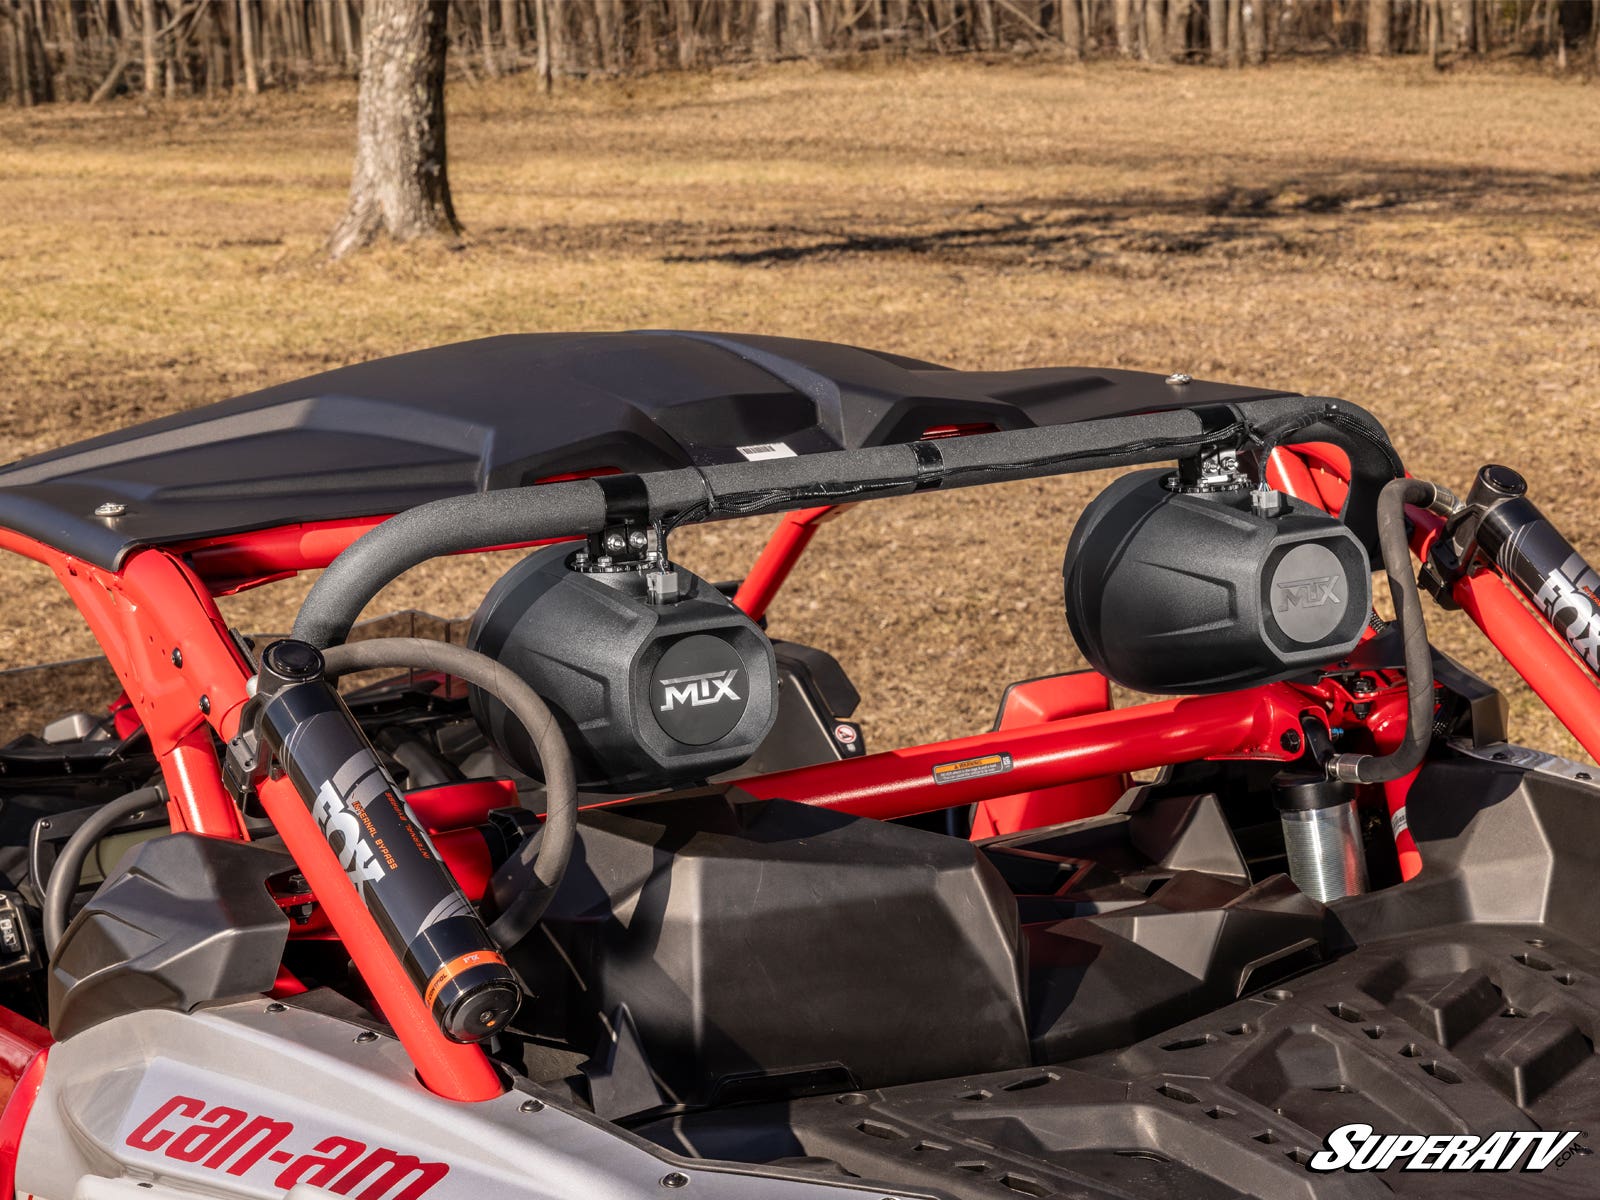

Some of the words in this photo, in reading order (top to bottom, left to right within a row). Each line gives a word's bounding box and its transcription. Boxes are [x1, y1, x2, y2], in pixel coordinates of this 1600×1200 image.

[1277, 576, 1340, 612] MTX
[660, 669, 741, 712] MTX
[312, 780, 386, 906] FOX
[352, 801, 377, 838] INTERNAL
[375, 838, 398, 870] BYPASS
[125, 1095, 450, 1200] can-am
